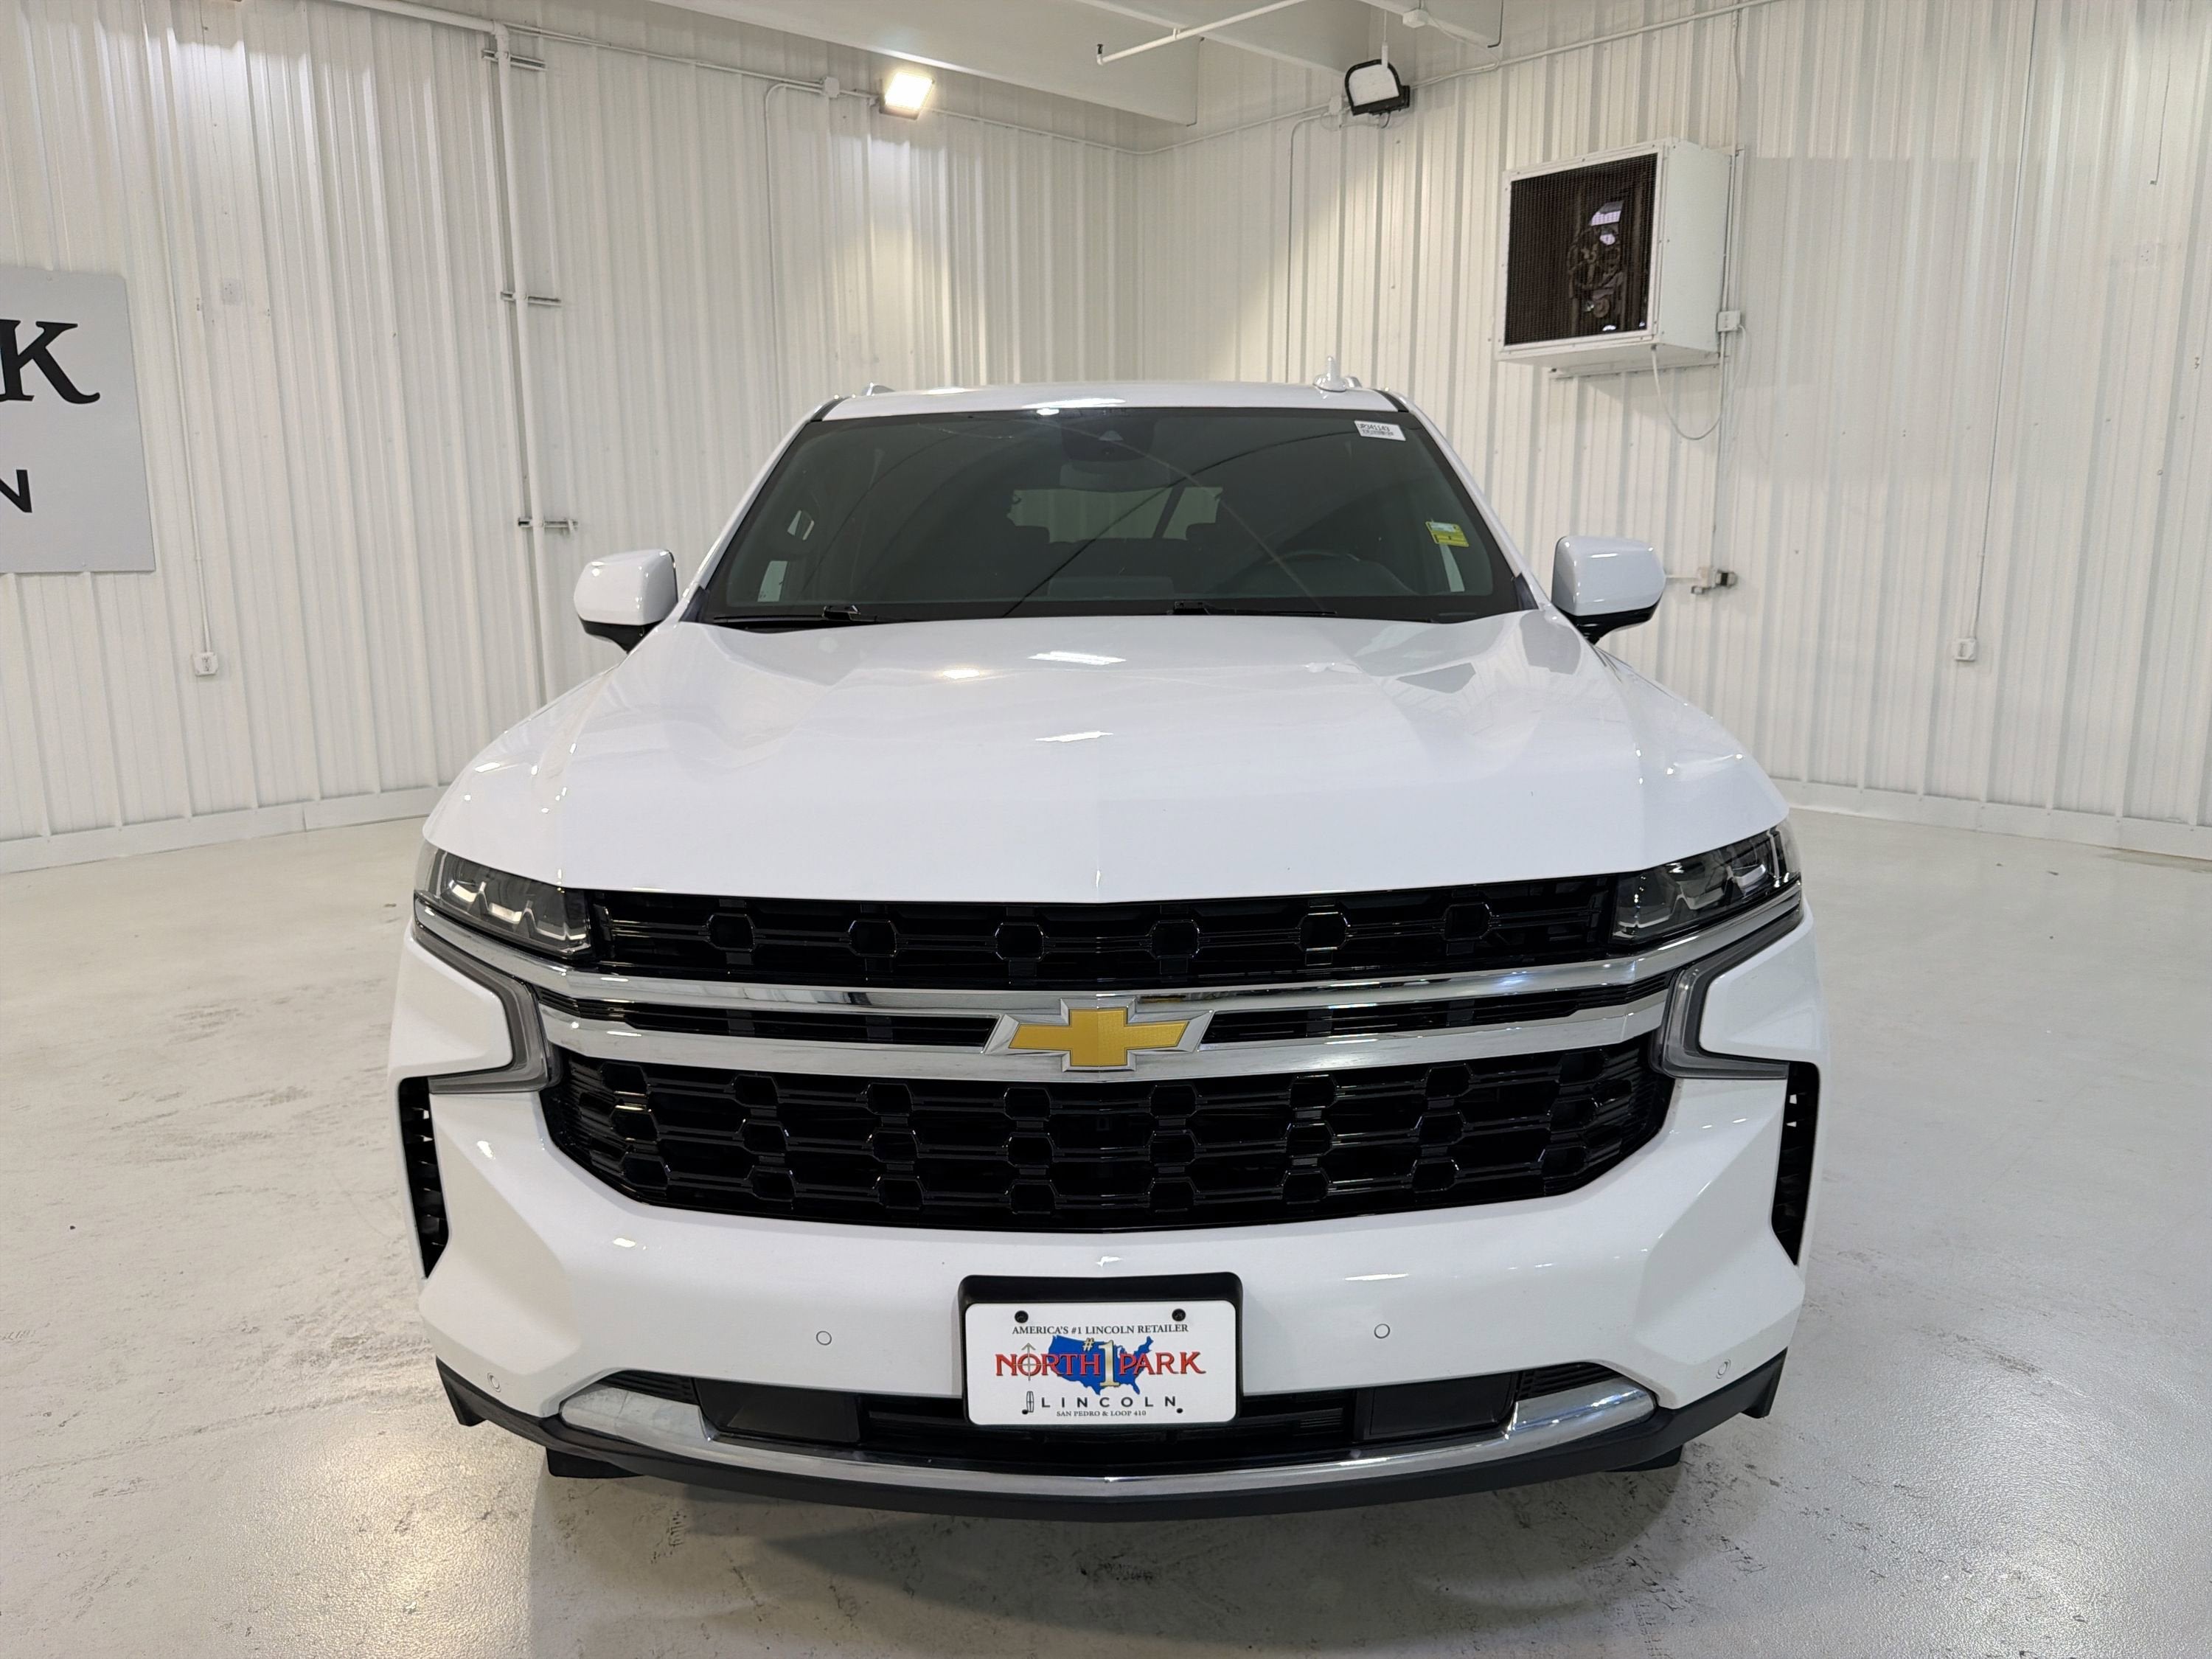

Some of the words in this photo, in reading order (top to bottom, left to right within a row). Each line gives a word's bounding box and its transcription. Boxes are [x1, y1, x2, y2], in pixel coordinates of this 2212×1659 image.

[1012, 1325, 1069, 1335] AMERICA'S
[1071, 1326, 1082, 1335] #1
[1085, 1325, 1135, 1335] LINCOLN
[1137, 1324, 1189, 1334] RETAILER
[995, 1352, 1101, 1377] NORTH
[1119, 1351, 1207, 1375] PARK
[1041, 1395, 1176, 1408] LINCOLN
